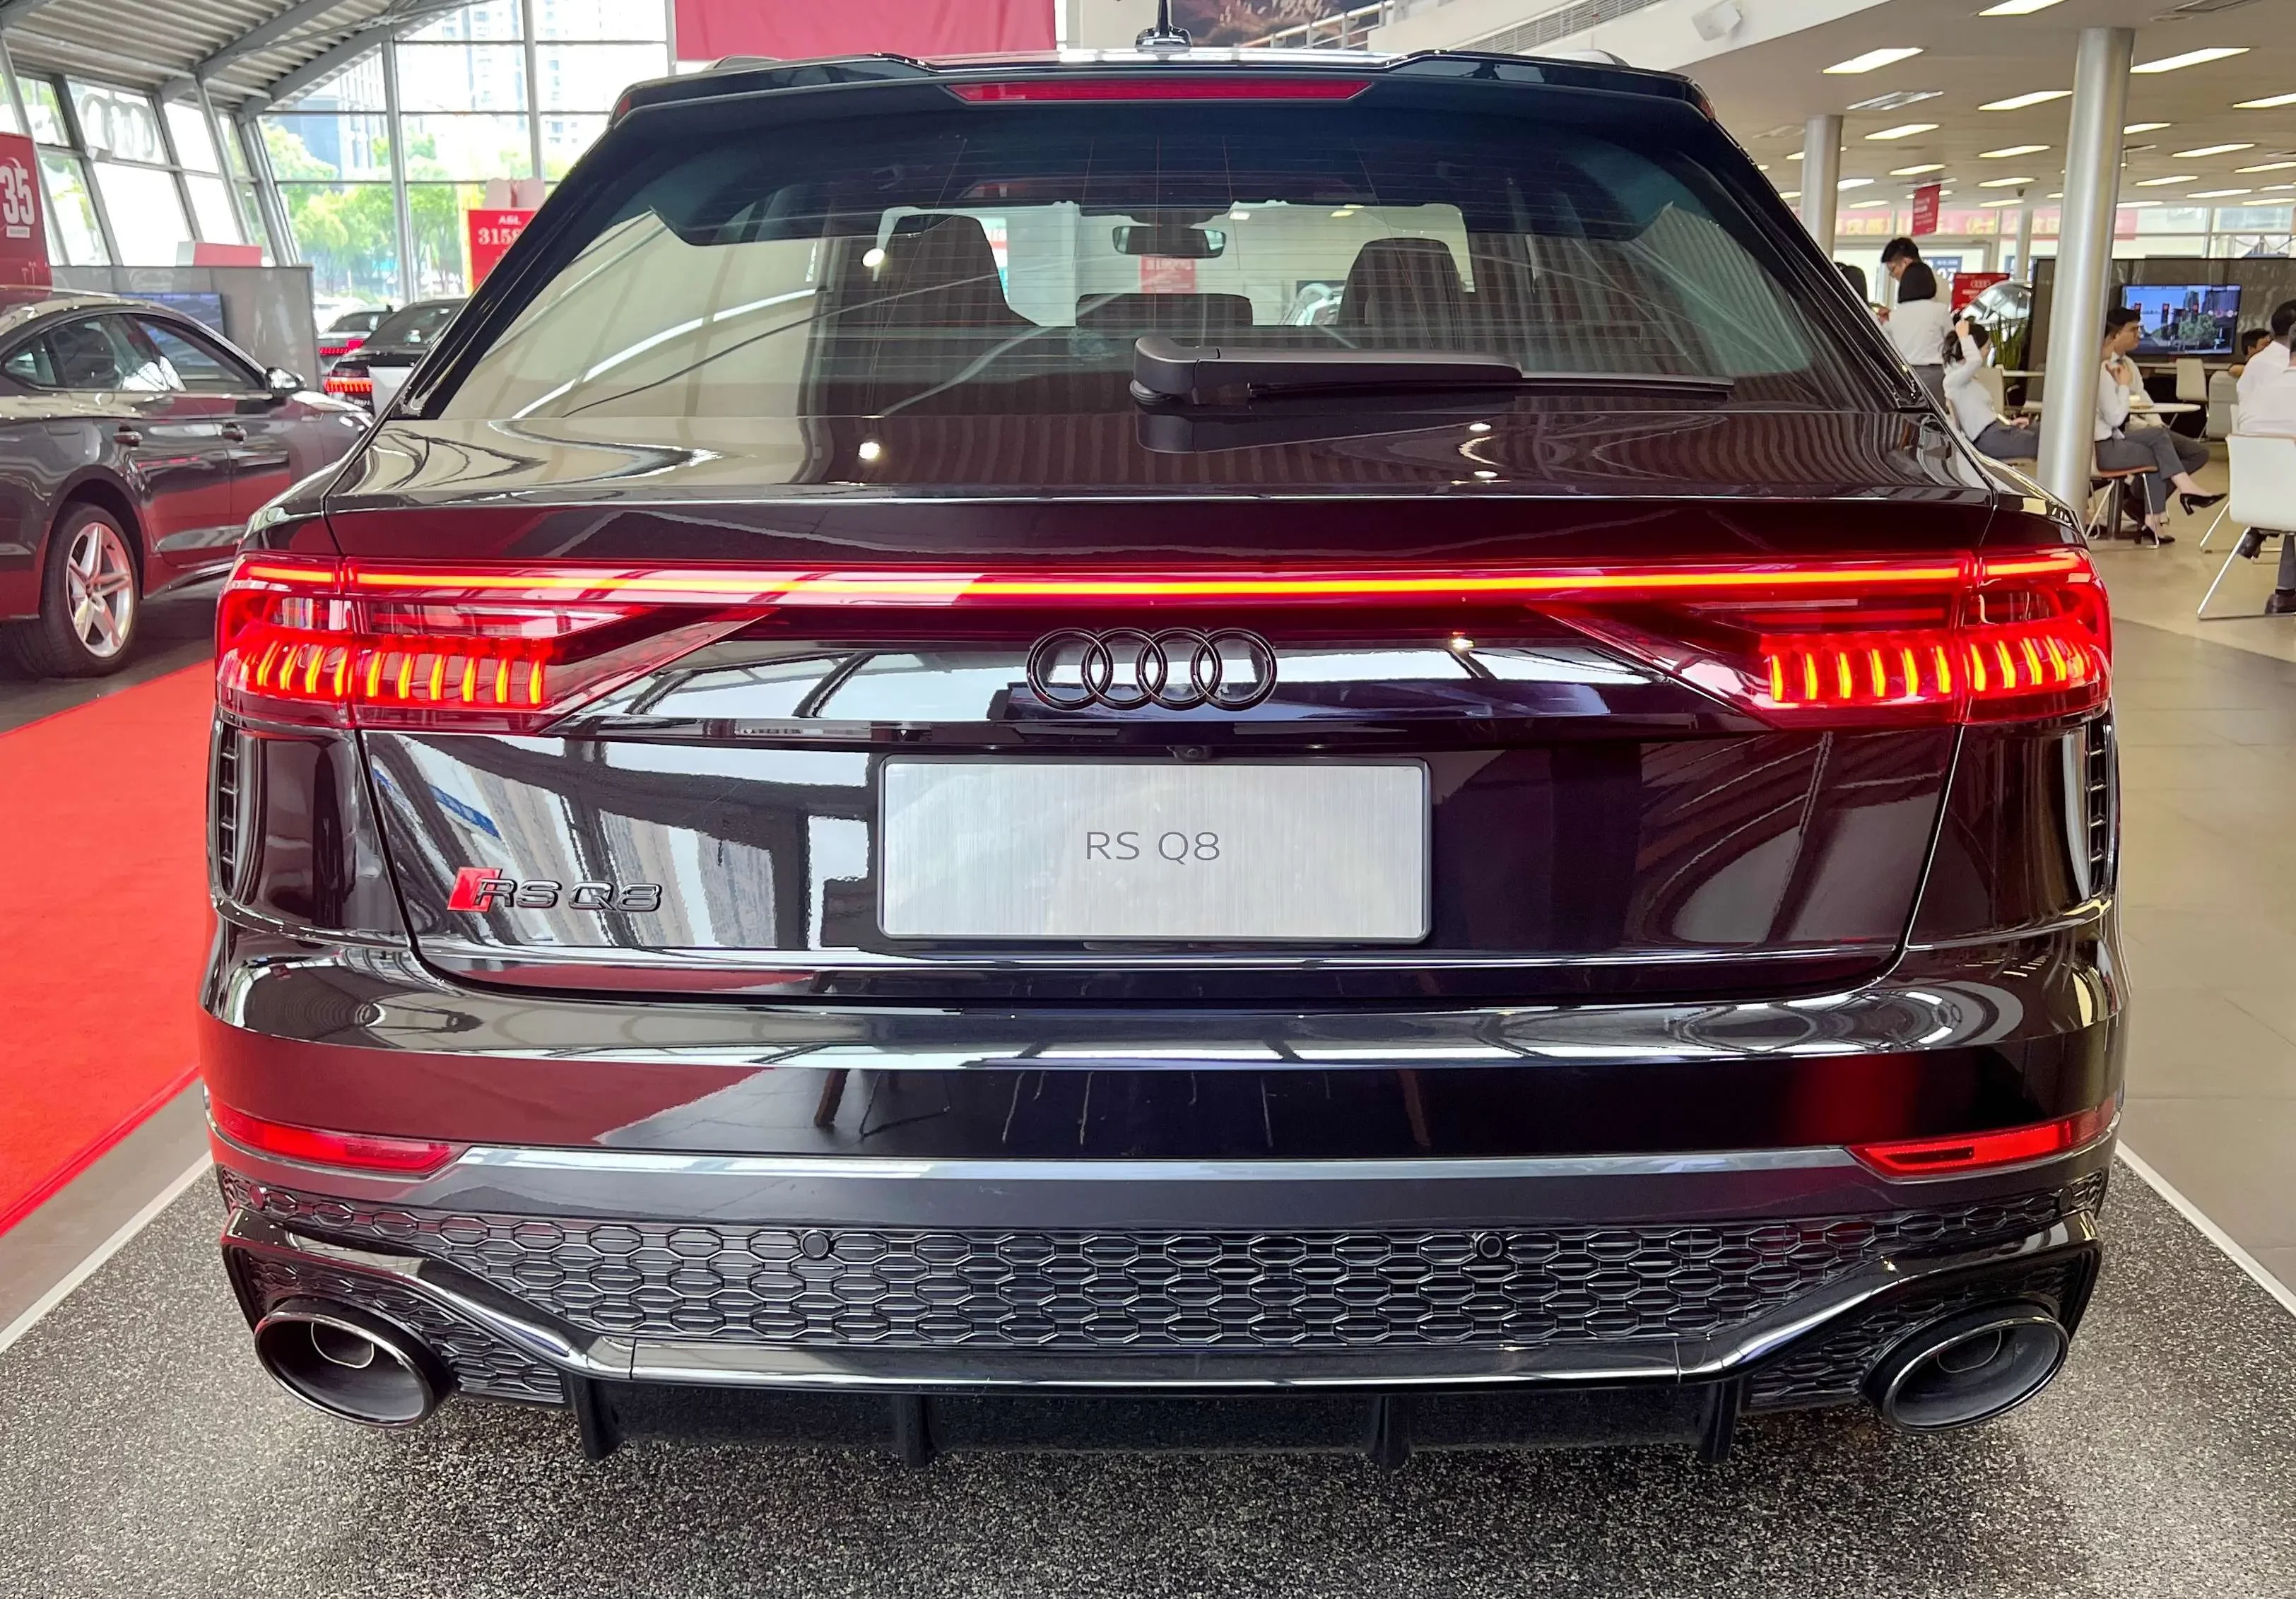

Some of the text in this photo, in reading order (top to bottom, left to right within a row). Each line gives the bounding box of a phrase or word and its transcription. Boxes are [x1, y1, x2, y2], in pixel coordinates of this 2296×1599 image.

[0, 165, 35, 225] 35
[1086, 831, 1220, 865] RS Q8
[471, 878, 662, 912] RS Q8
